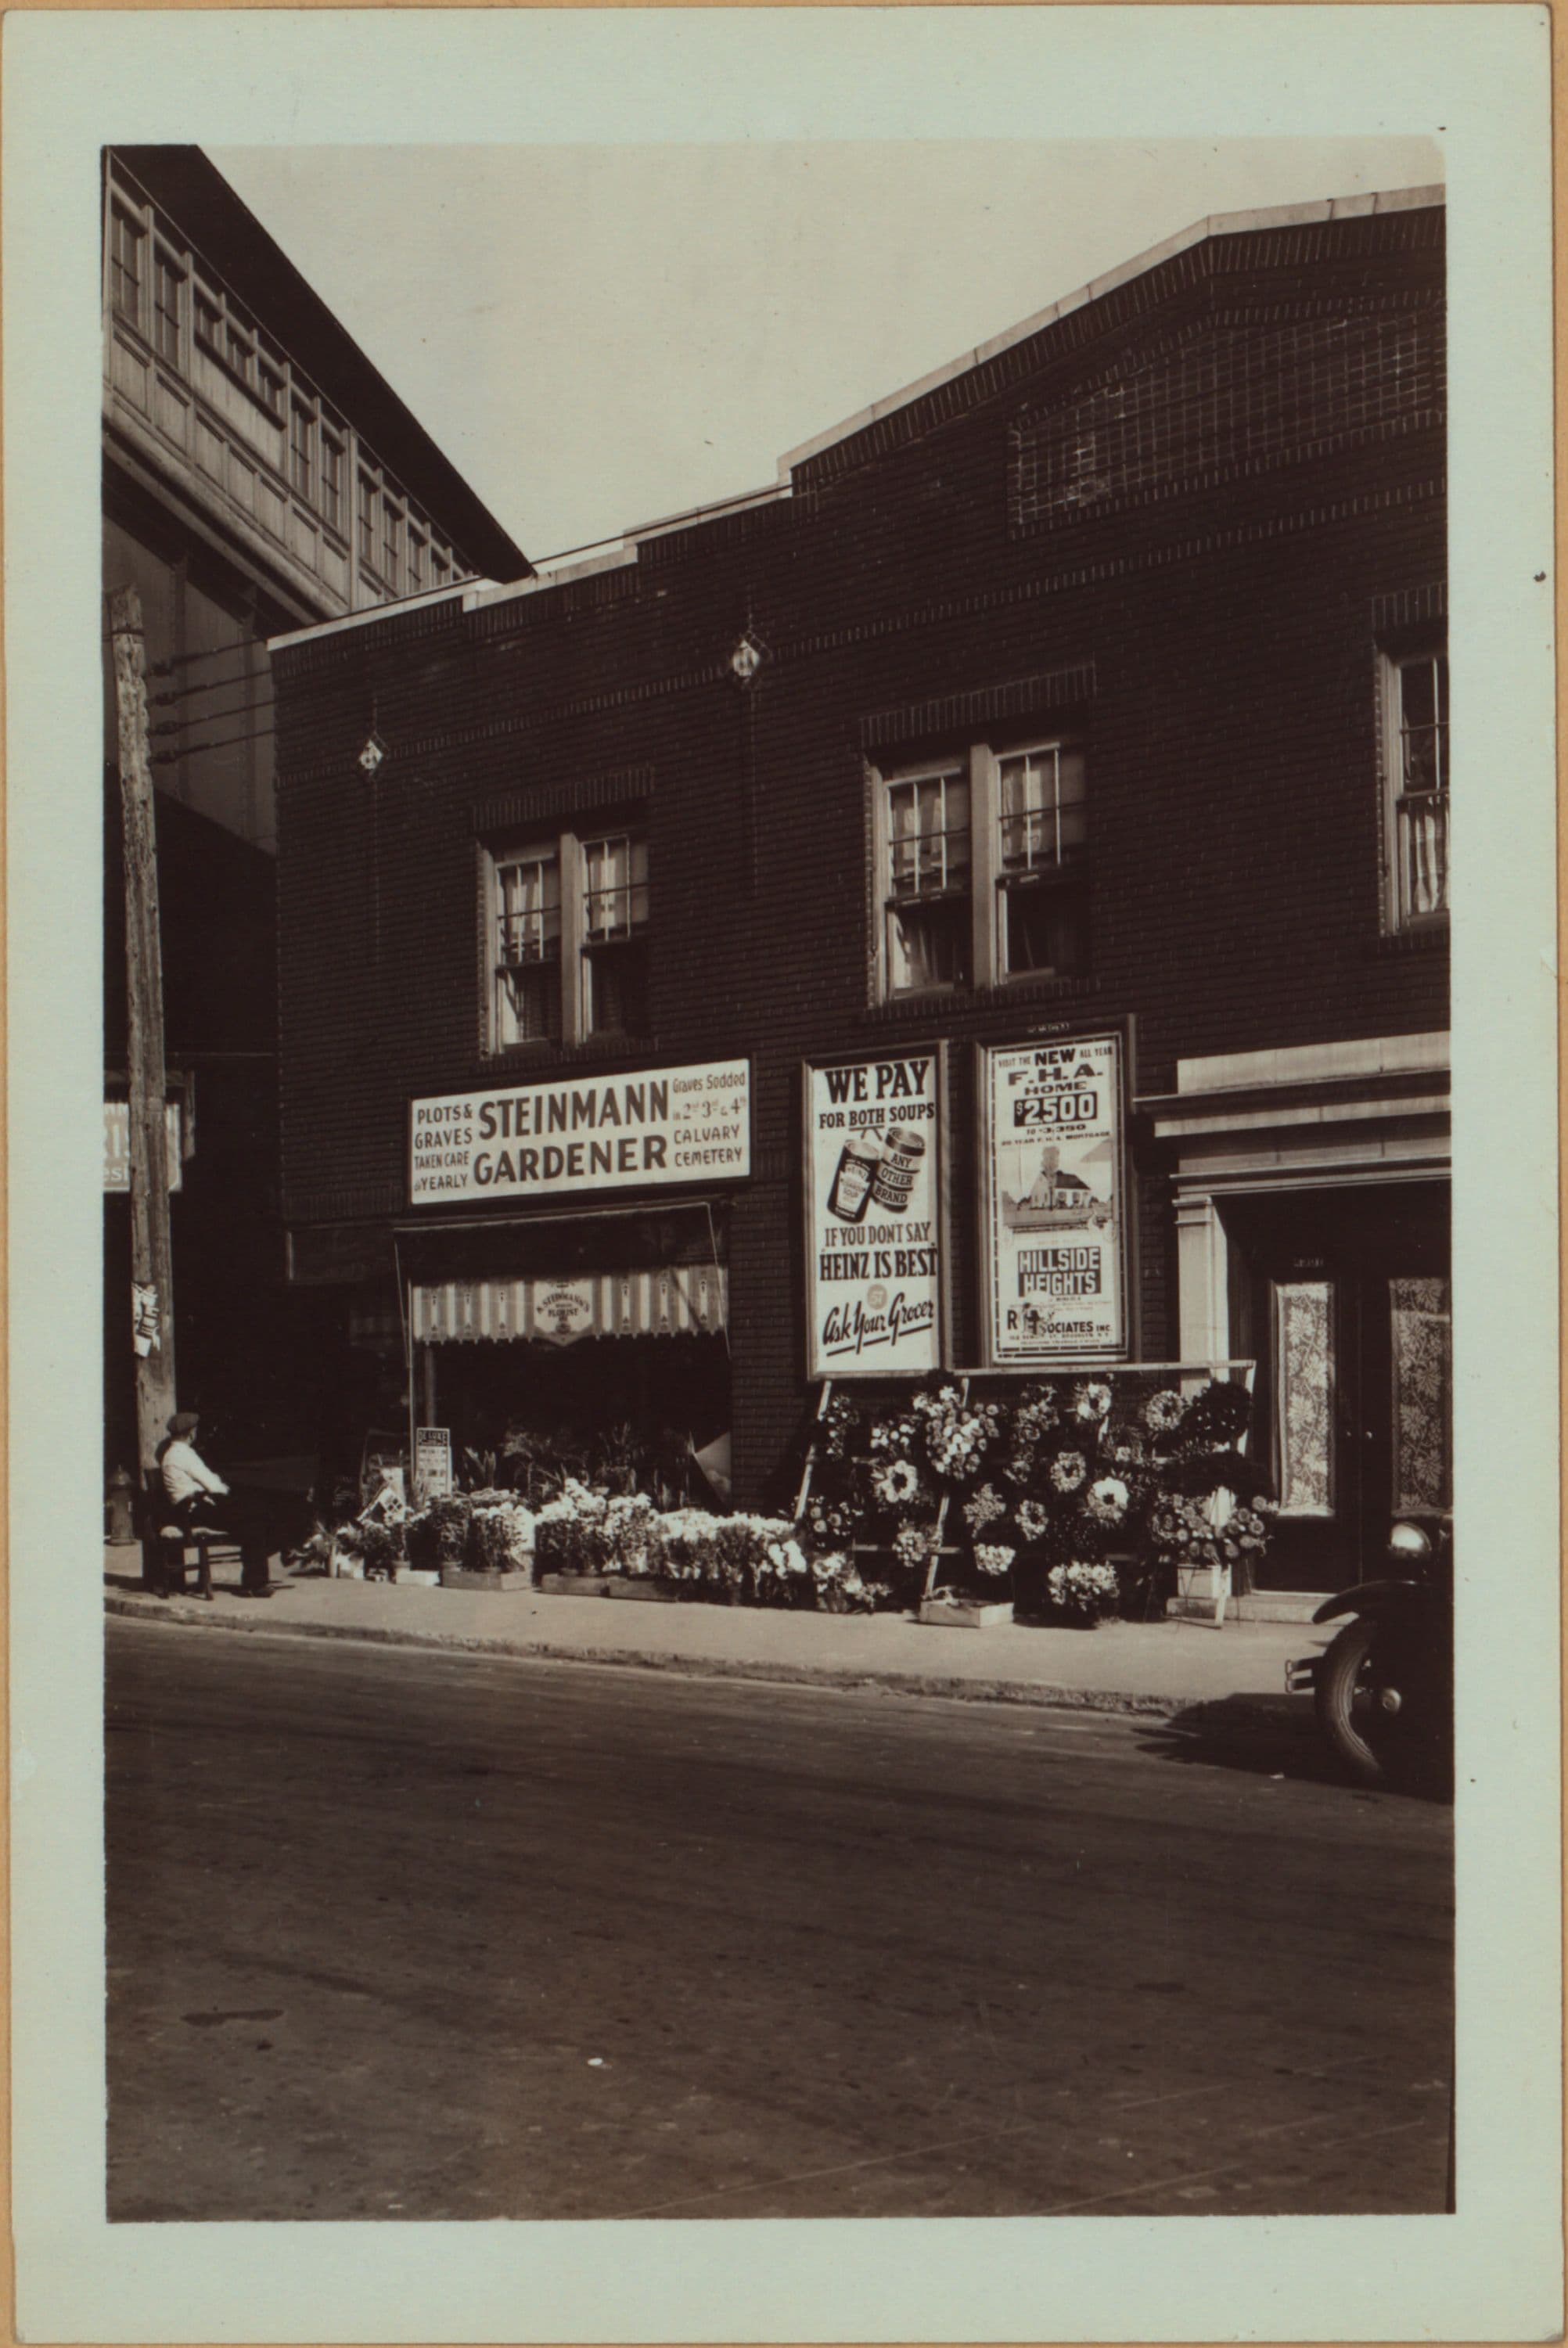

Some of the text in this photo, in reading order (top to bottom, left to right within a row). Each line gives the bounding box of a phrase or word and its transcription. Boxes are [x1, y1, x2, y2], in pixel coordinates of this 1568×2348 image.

[998, 1059, 1016, 1067] VISIT
[1019, 1056, 1031, 1065] THE
[1034, 1048, 1075, 1066] NEW
[673, 1071, 746, 1093] Graves Sodded
[825, 1059, 930, 1104] WE PAY
[1025, 1081, 1087, 1095] HOME
[418, 1104, 473, 1124] PLOTS &
[479, 1080, 669, 1140] STEINMANN
[819, 1102, 934, 1129] FOR BOTH SOUPS
[415, 1127, 473, 1149] GRAVES
[674, 1124, 740, 1144] CALVARY
[415, 1151, 469, 1170] TAKEN CARE
[474, 1134, 667, 1186] GARDENER
[674, 1147, 743, 1167] CEMETERY
[891, 1153, 913, 1168] ANY
[420, 1174, 468, 1191] YEARLY
[882, 1167, 913, 1185] OTHER
[876, 1185, 908, 1203] BRAND
[825, 1228, 838, 1247] IF
[840, 1226, 865, 1246] YOU
[906, 1221, 931, 1242] SAY
[874, 1250, 892, 1278] IS
[1020, 1247, 1099, 1273] HILLSIDE
[1024, 1271, 1096, 1296] HEIGHTS
[823, 1292, 934, 1355] Ask Your Grocer
